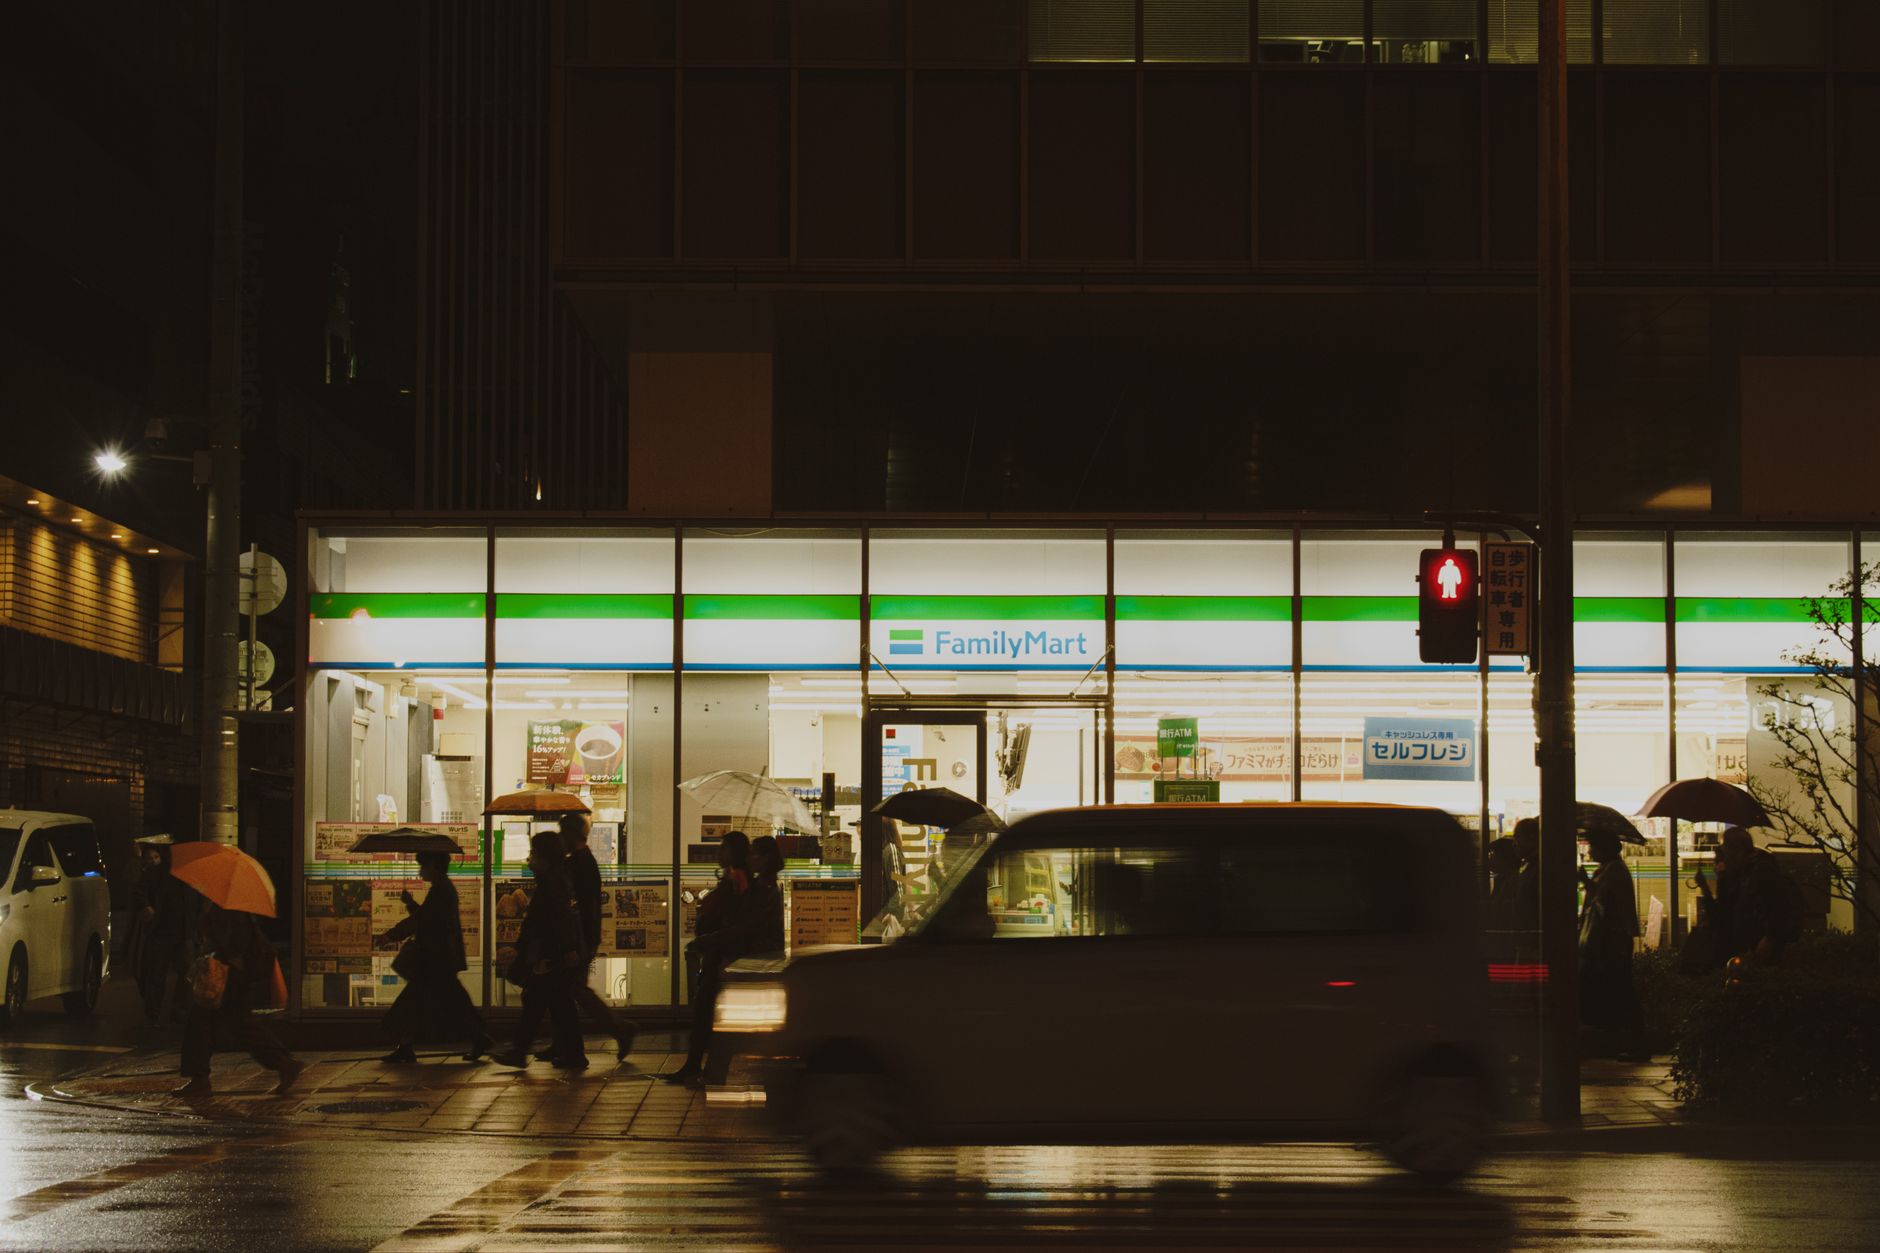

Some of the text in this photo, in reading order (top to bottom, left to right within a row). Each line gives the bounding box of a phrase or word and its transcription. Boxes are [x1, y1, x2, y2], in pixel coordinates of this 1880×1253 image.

[1490, 550, 1508, 608] 自転車
[1508, 550, 1526, 608] 歩行者
[935, 630, 1088, 659] FamilyMart
[1498, 610, 1516, 649] 専用
[1371, 741, 1467, 761] セルフレジ
[1385, 730, 1454, 740] キャッシュレス専用
